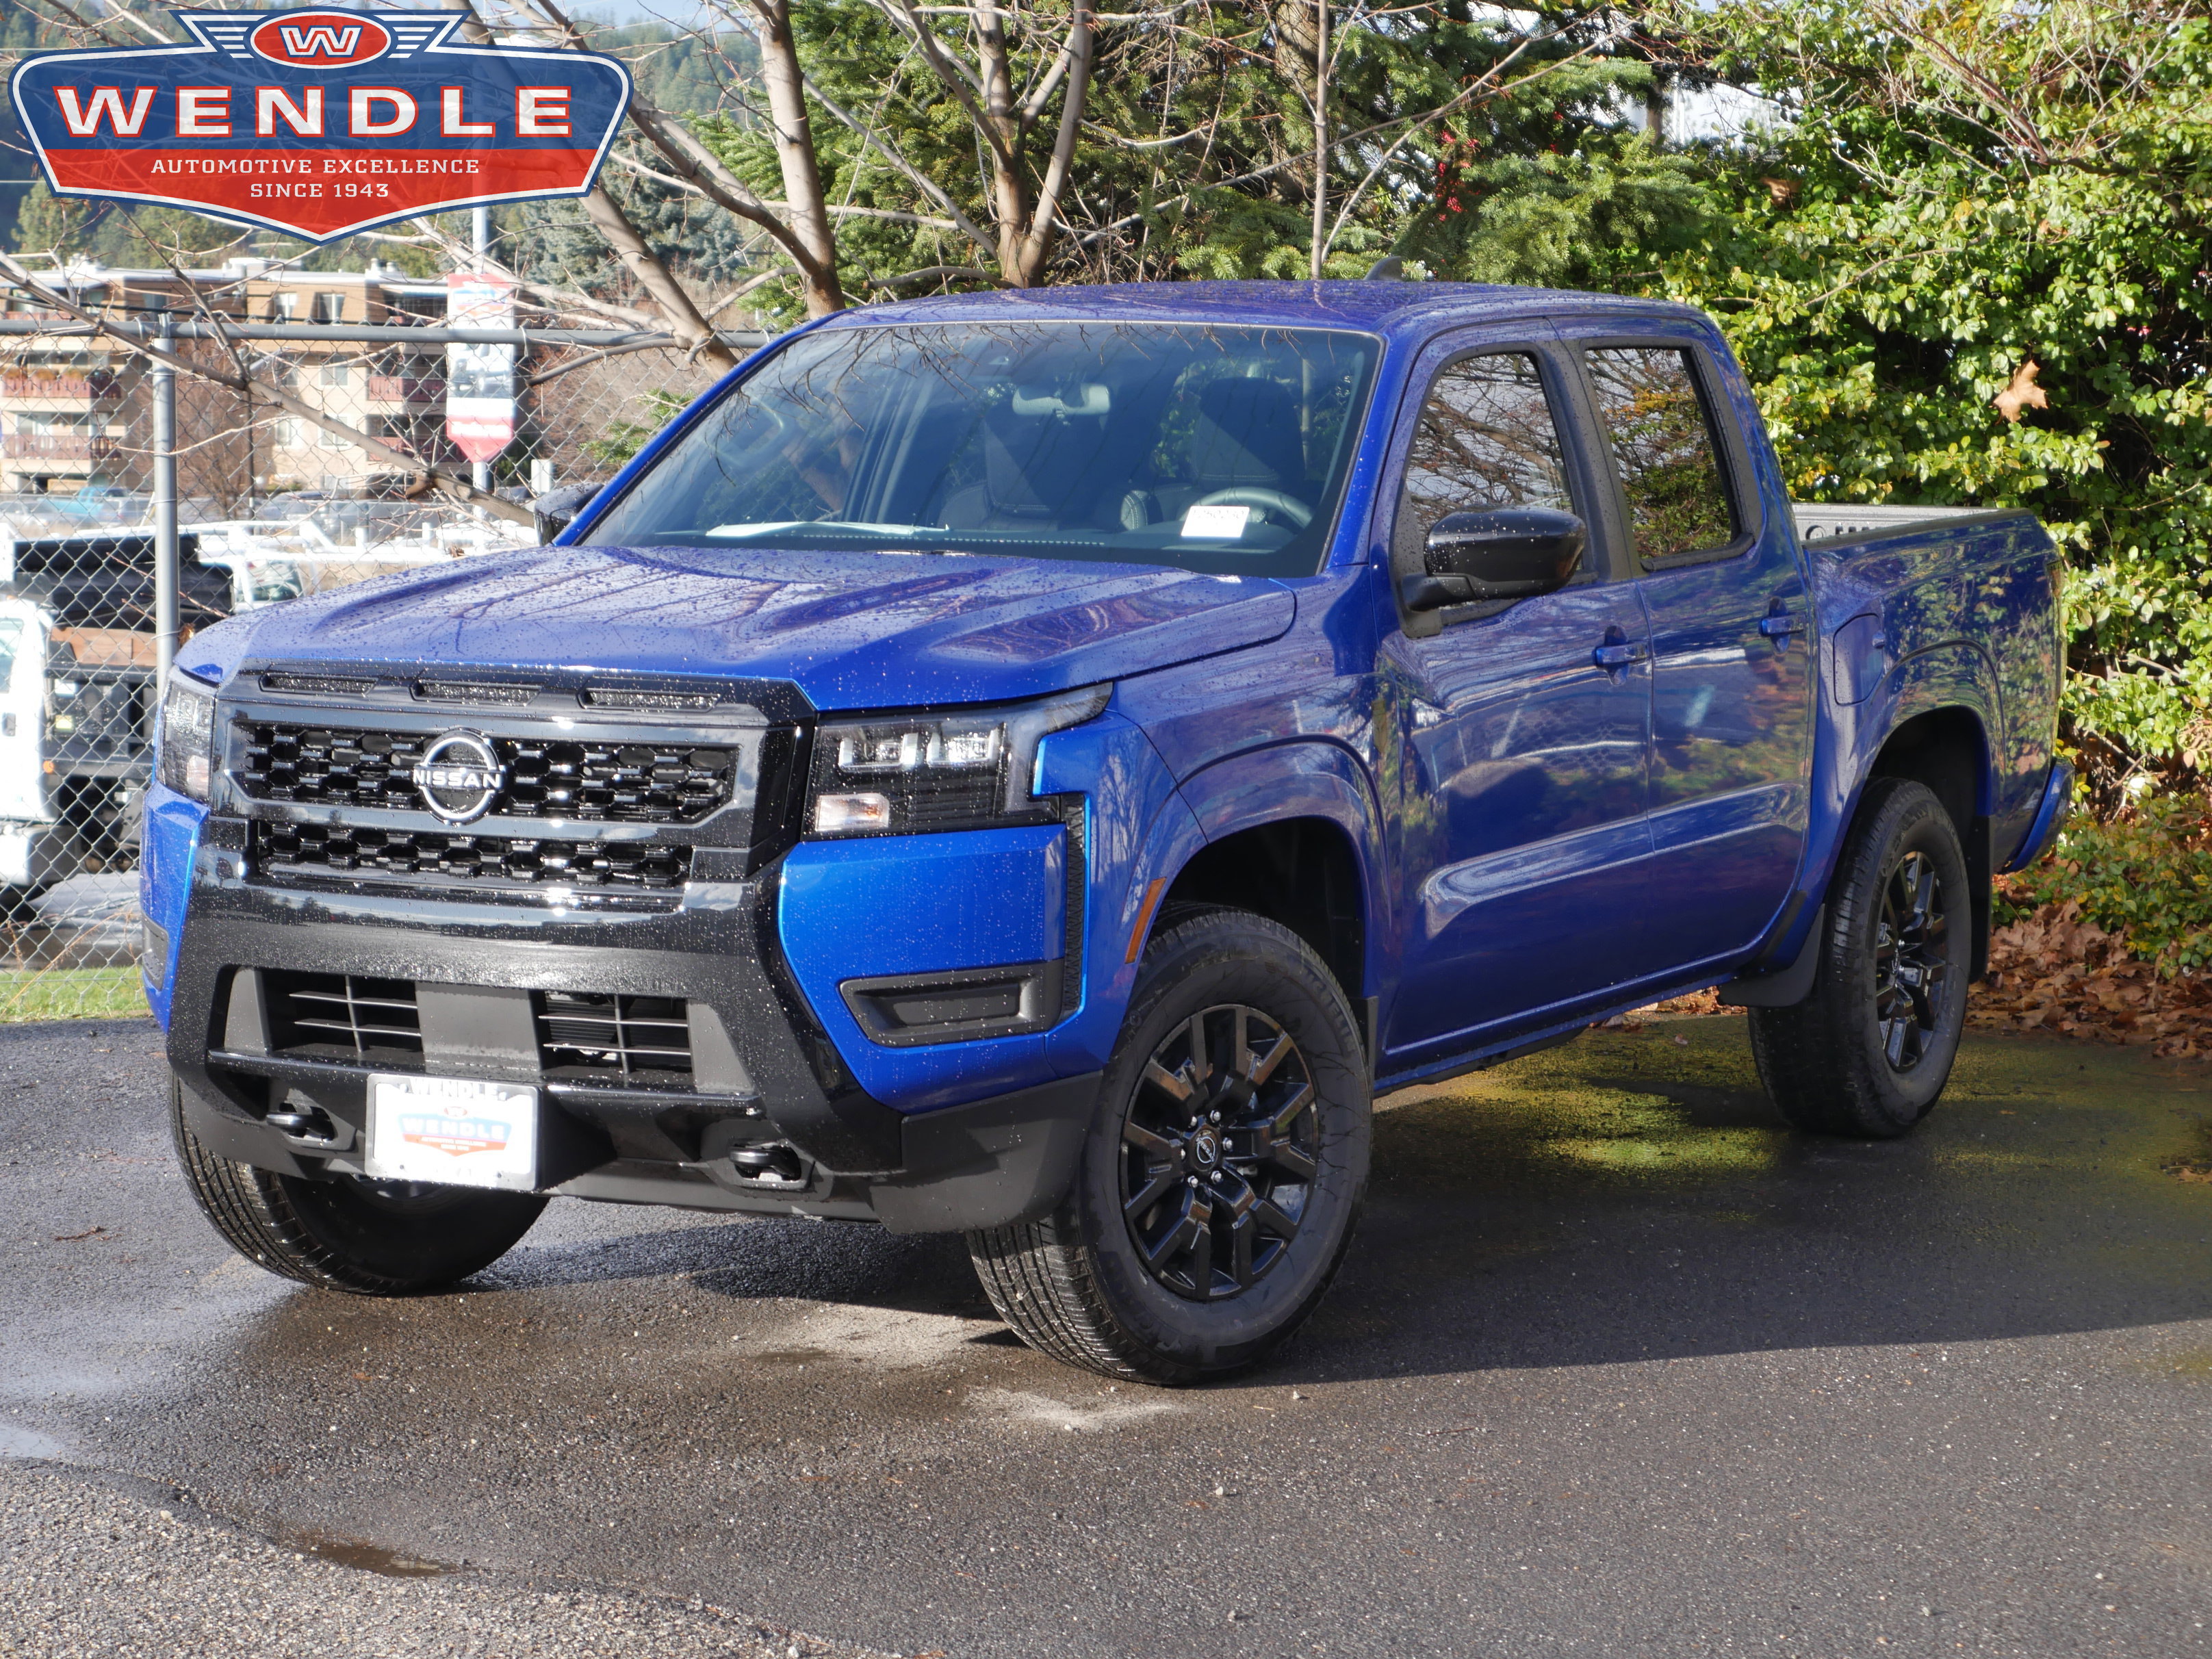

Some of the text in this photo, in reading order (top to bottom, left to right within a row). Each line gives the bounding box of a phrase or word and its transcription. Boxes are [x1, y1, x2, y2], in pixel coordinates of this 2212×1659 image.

[413, 769, 502, 788] NISSAN
[410, 1077, 498, 1098] WENDLE
[402, 1118, 504, 1140] WENDLE
